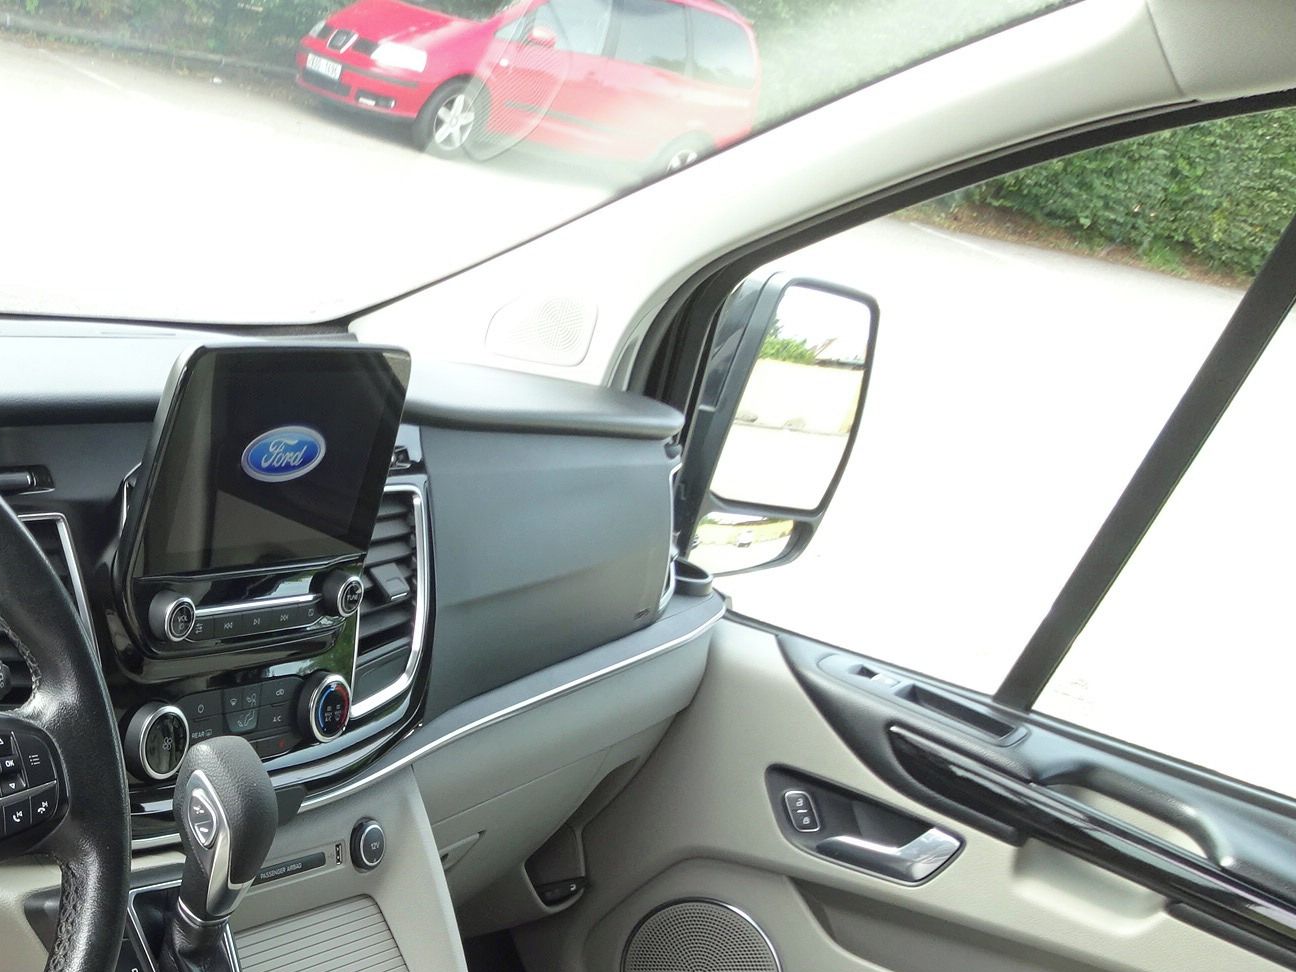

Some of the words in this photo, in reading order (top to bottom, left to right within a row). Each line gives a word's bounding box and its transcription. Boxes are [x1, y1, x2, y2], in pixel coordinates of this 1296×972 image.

[261, 438, 307, 468] Ford
[370, 842, 380, 850] 12V
[260, 867, 286, 879] PASSENGER
[287, 862, 302, 872] AIRBAG
